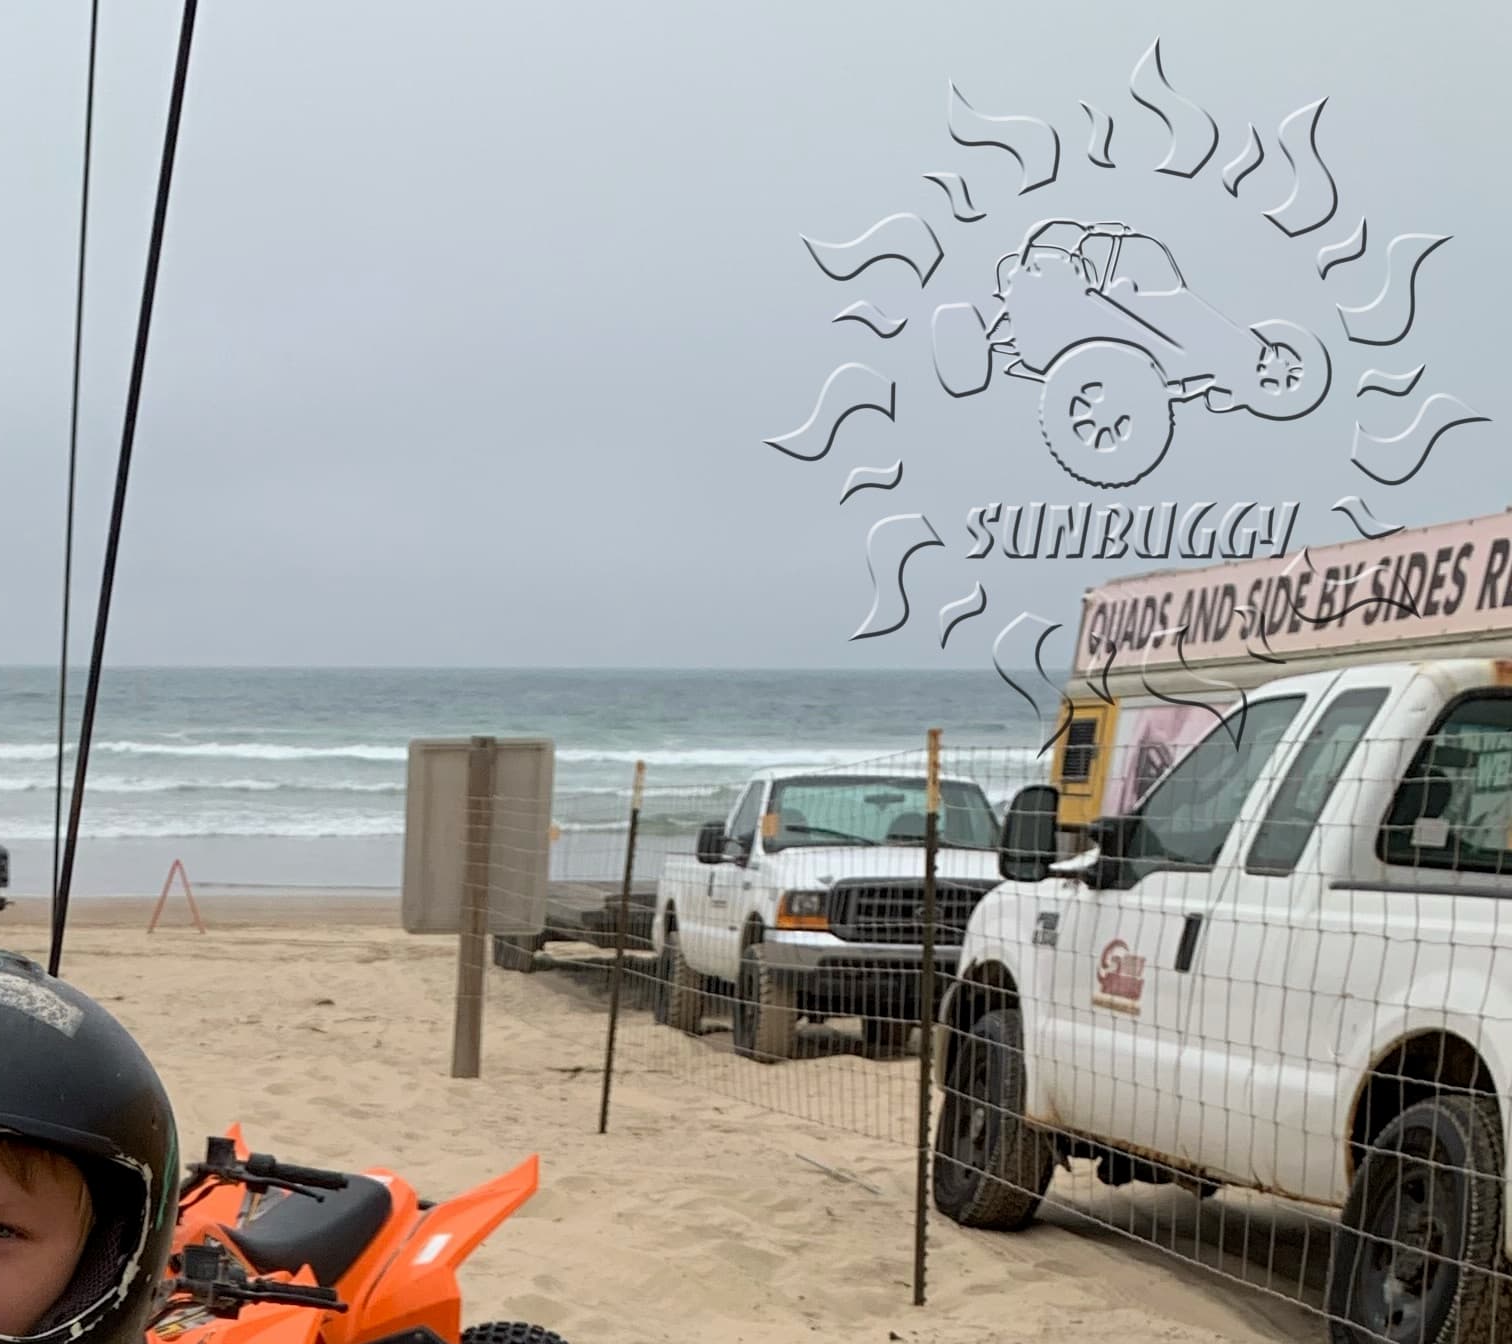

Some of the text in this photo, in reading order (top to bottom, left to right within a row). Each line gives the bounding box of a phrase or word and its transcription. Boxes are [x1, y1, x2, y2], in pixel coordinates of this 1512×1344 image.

[1089, 592, 1173, 655] QUADS
[1171, 583, 1237, 646] AND
[1240, 572, 1312, 641] SIDE
[1313, 561, 1365, 632] BY
[1363, 542, 1475, 626] SIDES
